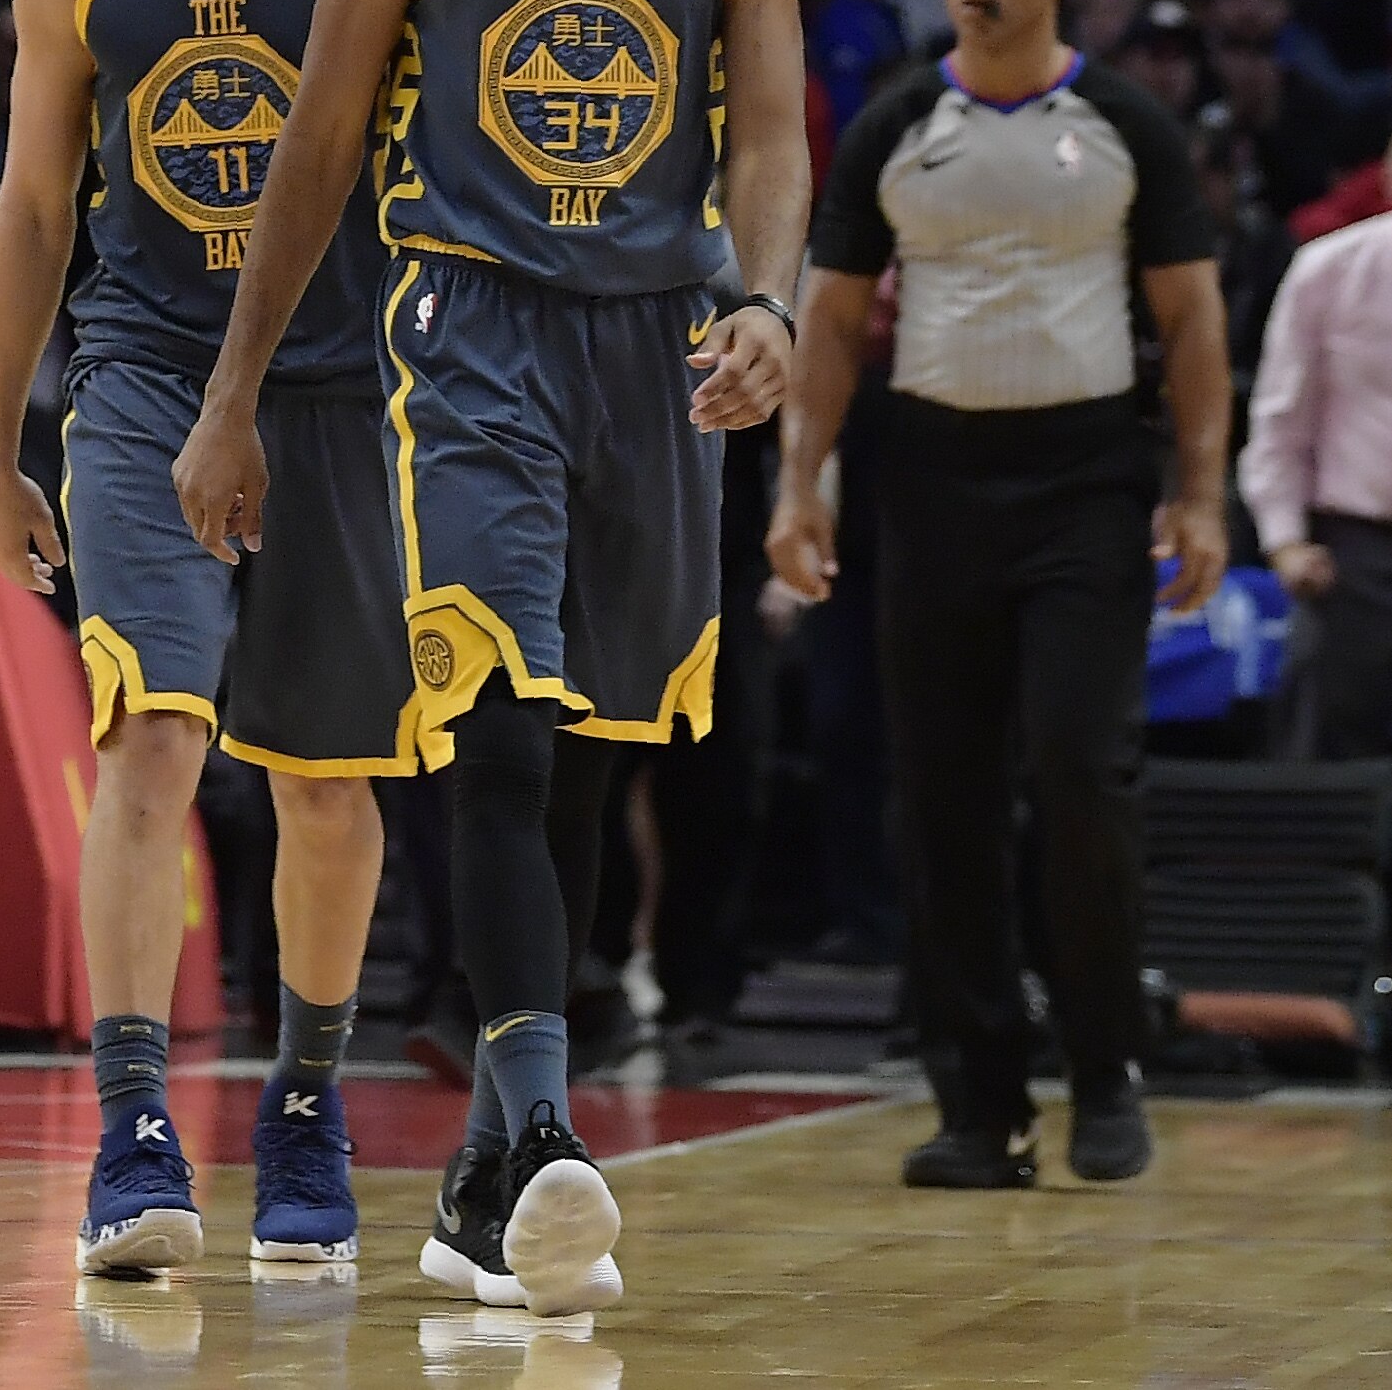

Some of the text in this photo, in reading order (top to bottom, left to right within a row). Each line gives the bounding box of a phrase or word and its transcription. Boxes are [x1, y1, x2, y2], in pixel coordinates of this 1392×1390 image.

[552, 13, 615, 47] 勇士
[191, 67, 251, 101] 勇士
[542, 101, 621, 151] 34
[207, 145, 250, 194] 11
[549, 187, 607, 226] BAY
